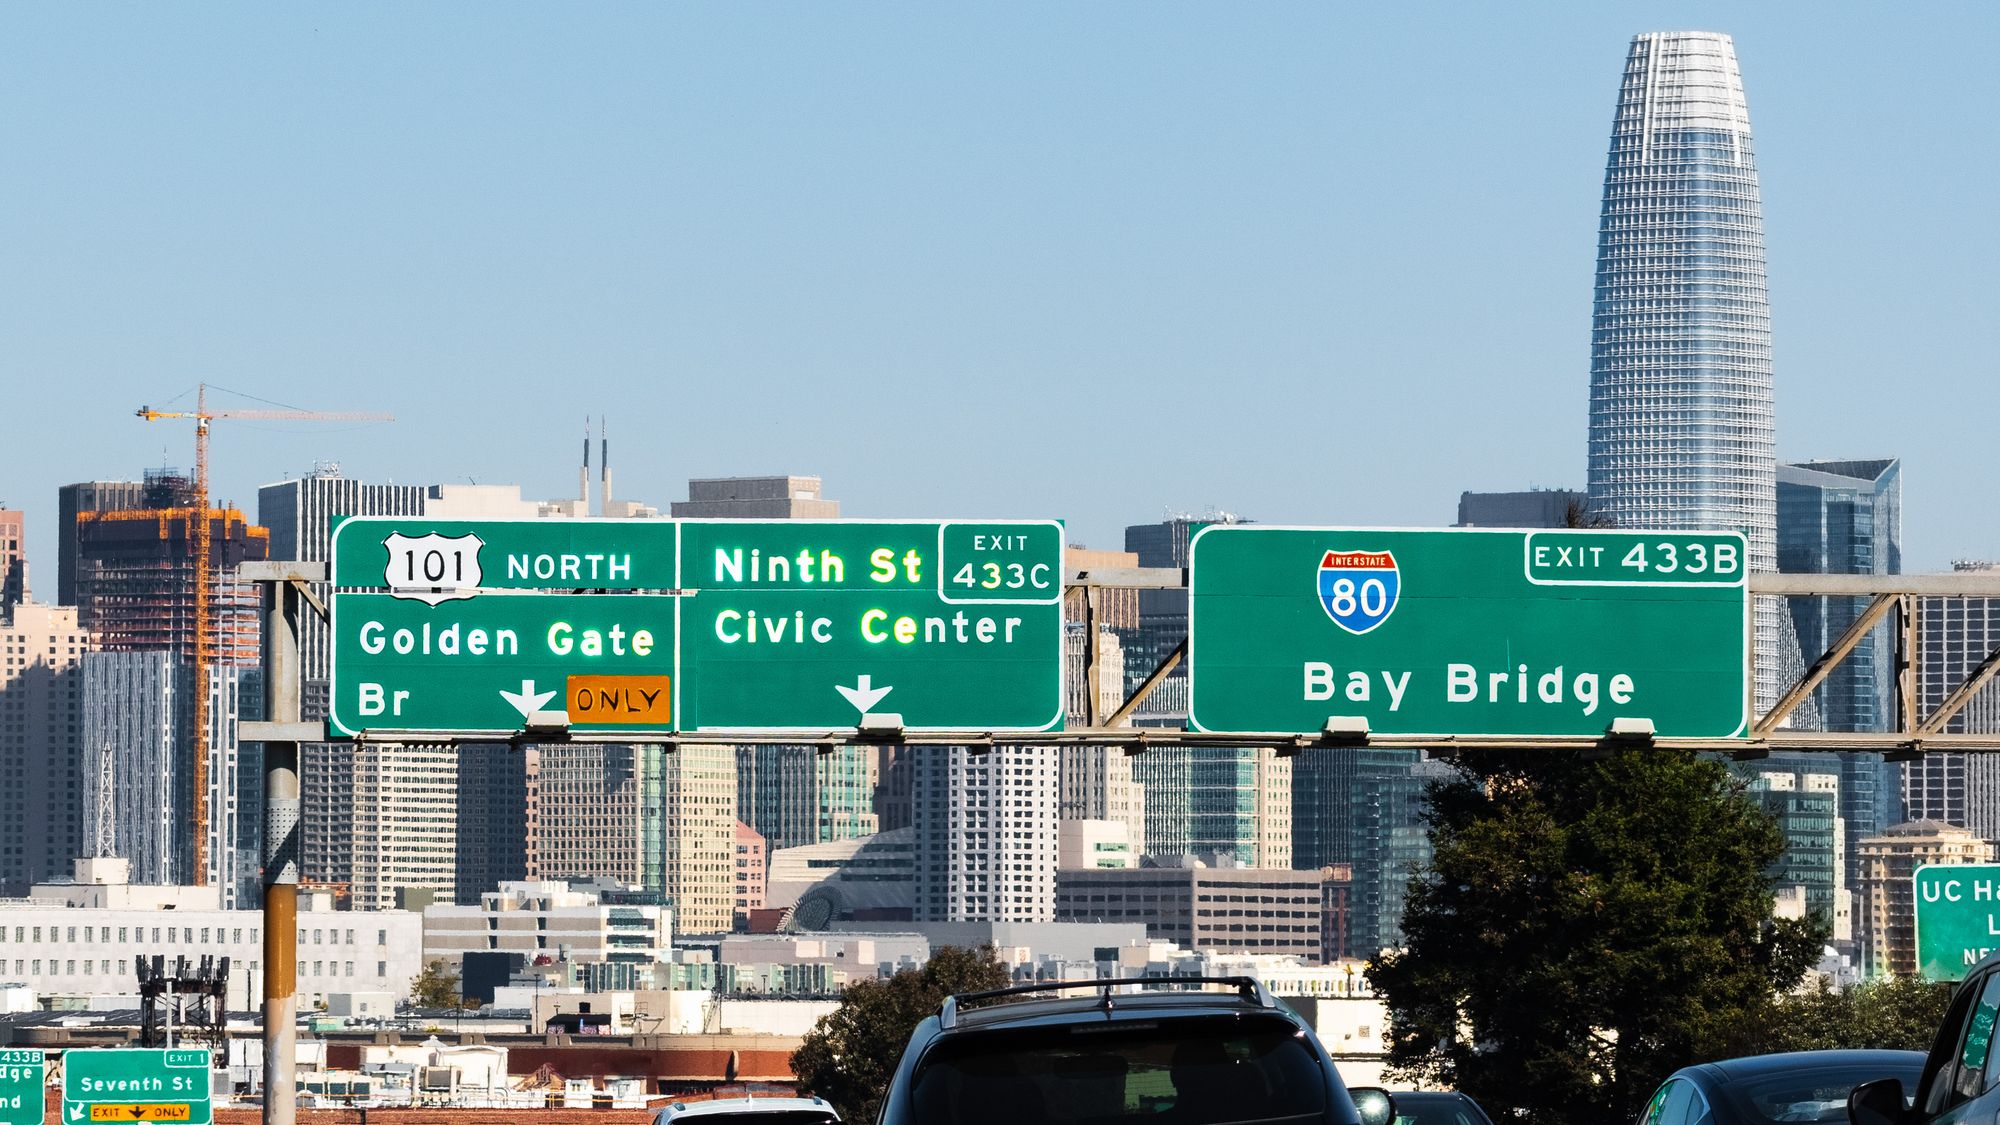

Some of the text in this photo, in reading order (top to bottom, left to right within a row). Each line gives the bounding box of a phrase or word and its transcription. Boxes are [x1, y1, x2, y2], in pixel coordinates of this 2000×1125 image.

[974, 535, 1028, 551] EXIT
[404, 549, 463, 582] 101
[508, 554, 631, 580] NORTH
[714, 547, 922, 583] Ninth St
[1331, 557, 1386, 566] INTERSTATE
[1535, 542, 1738, 574] EXIT 433B
[952, 562, 1051, 589] 433C
[1331, 578, 1387, 617] 80
[359, 620, 654, 656] Golden Gate
[714, 608, 1022, 644] Civic Center
[358, 682, 410, 716] Br
[577, 688, 662, 712] ONLY
[1303, 661, 1635, 717] Bay Bridge
[1922, 879, 2000, 902] UC H
[1, 1051, 41, 1063] 433B
[169, 1053, 204, 1064] EXIT 1
[81, 1076, 193, 1092] Seventh St
[93, 1107, 186, 1117] EXIT ONLY
